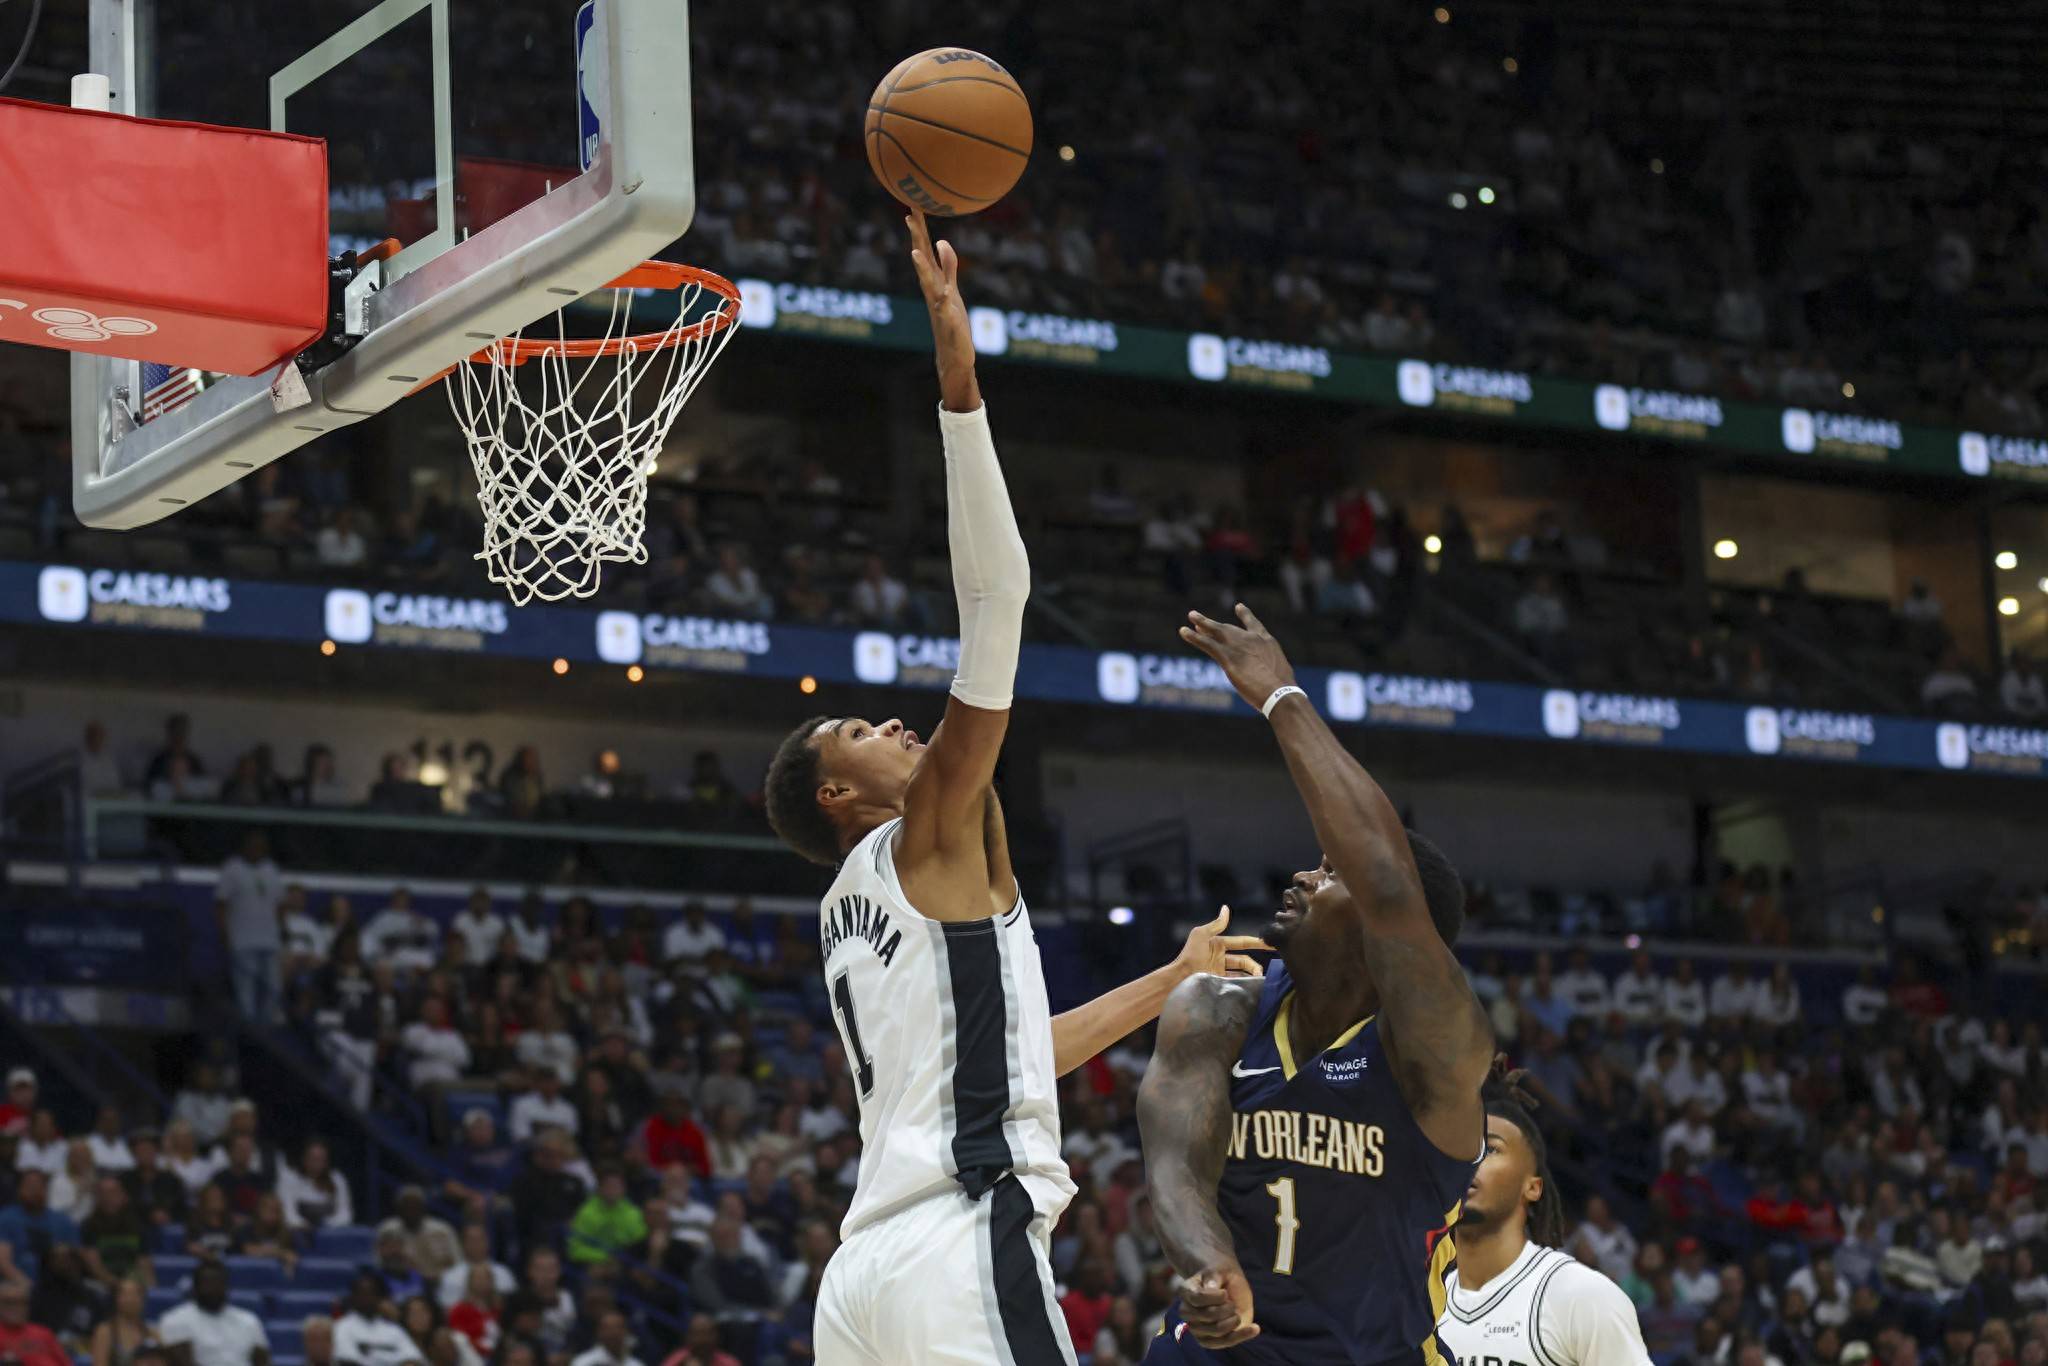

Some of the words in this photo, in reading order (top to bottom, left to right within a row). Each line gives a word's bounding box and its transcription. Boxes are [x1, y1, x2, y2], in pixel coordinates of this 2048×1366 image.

[775, 283, 893, 325] CAESARS
[1006, 310, 1118, 352] CAESARS
[1226, 336, 1331, 377] CAESARS
[1433, 362, 1532, 403] CAESARS
[1629, 387, 1723, 427] CAESARS
[1814, 410, 1902, 449] CAESARS
[1988, 433, 2048, 468] CAESA
[89, 568, 231, 612] CAESARS
[373, 594, 507, 634] CAESARS
[643, 614, 769, 655] CAESARS
[1140, 655, 1235, 690] CAESA
[1365, 672, 1474, 712] CAESARS
[1579, 692, 1681, 730] CAESARS
[1780, 708, 1876, 745] CAESARS
[823, 894, 902, 968] BANYAMA
[833, 966, 875, 1103] 1
[1325, 1072, 1360, 1081] GARAGE
[1253, 1110, 1384, 1177] ORLEANS
[1266, 1177, 1299, 1275] 1
[1488, 1326, 1515, 1334] LEDGER
